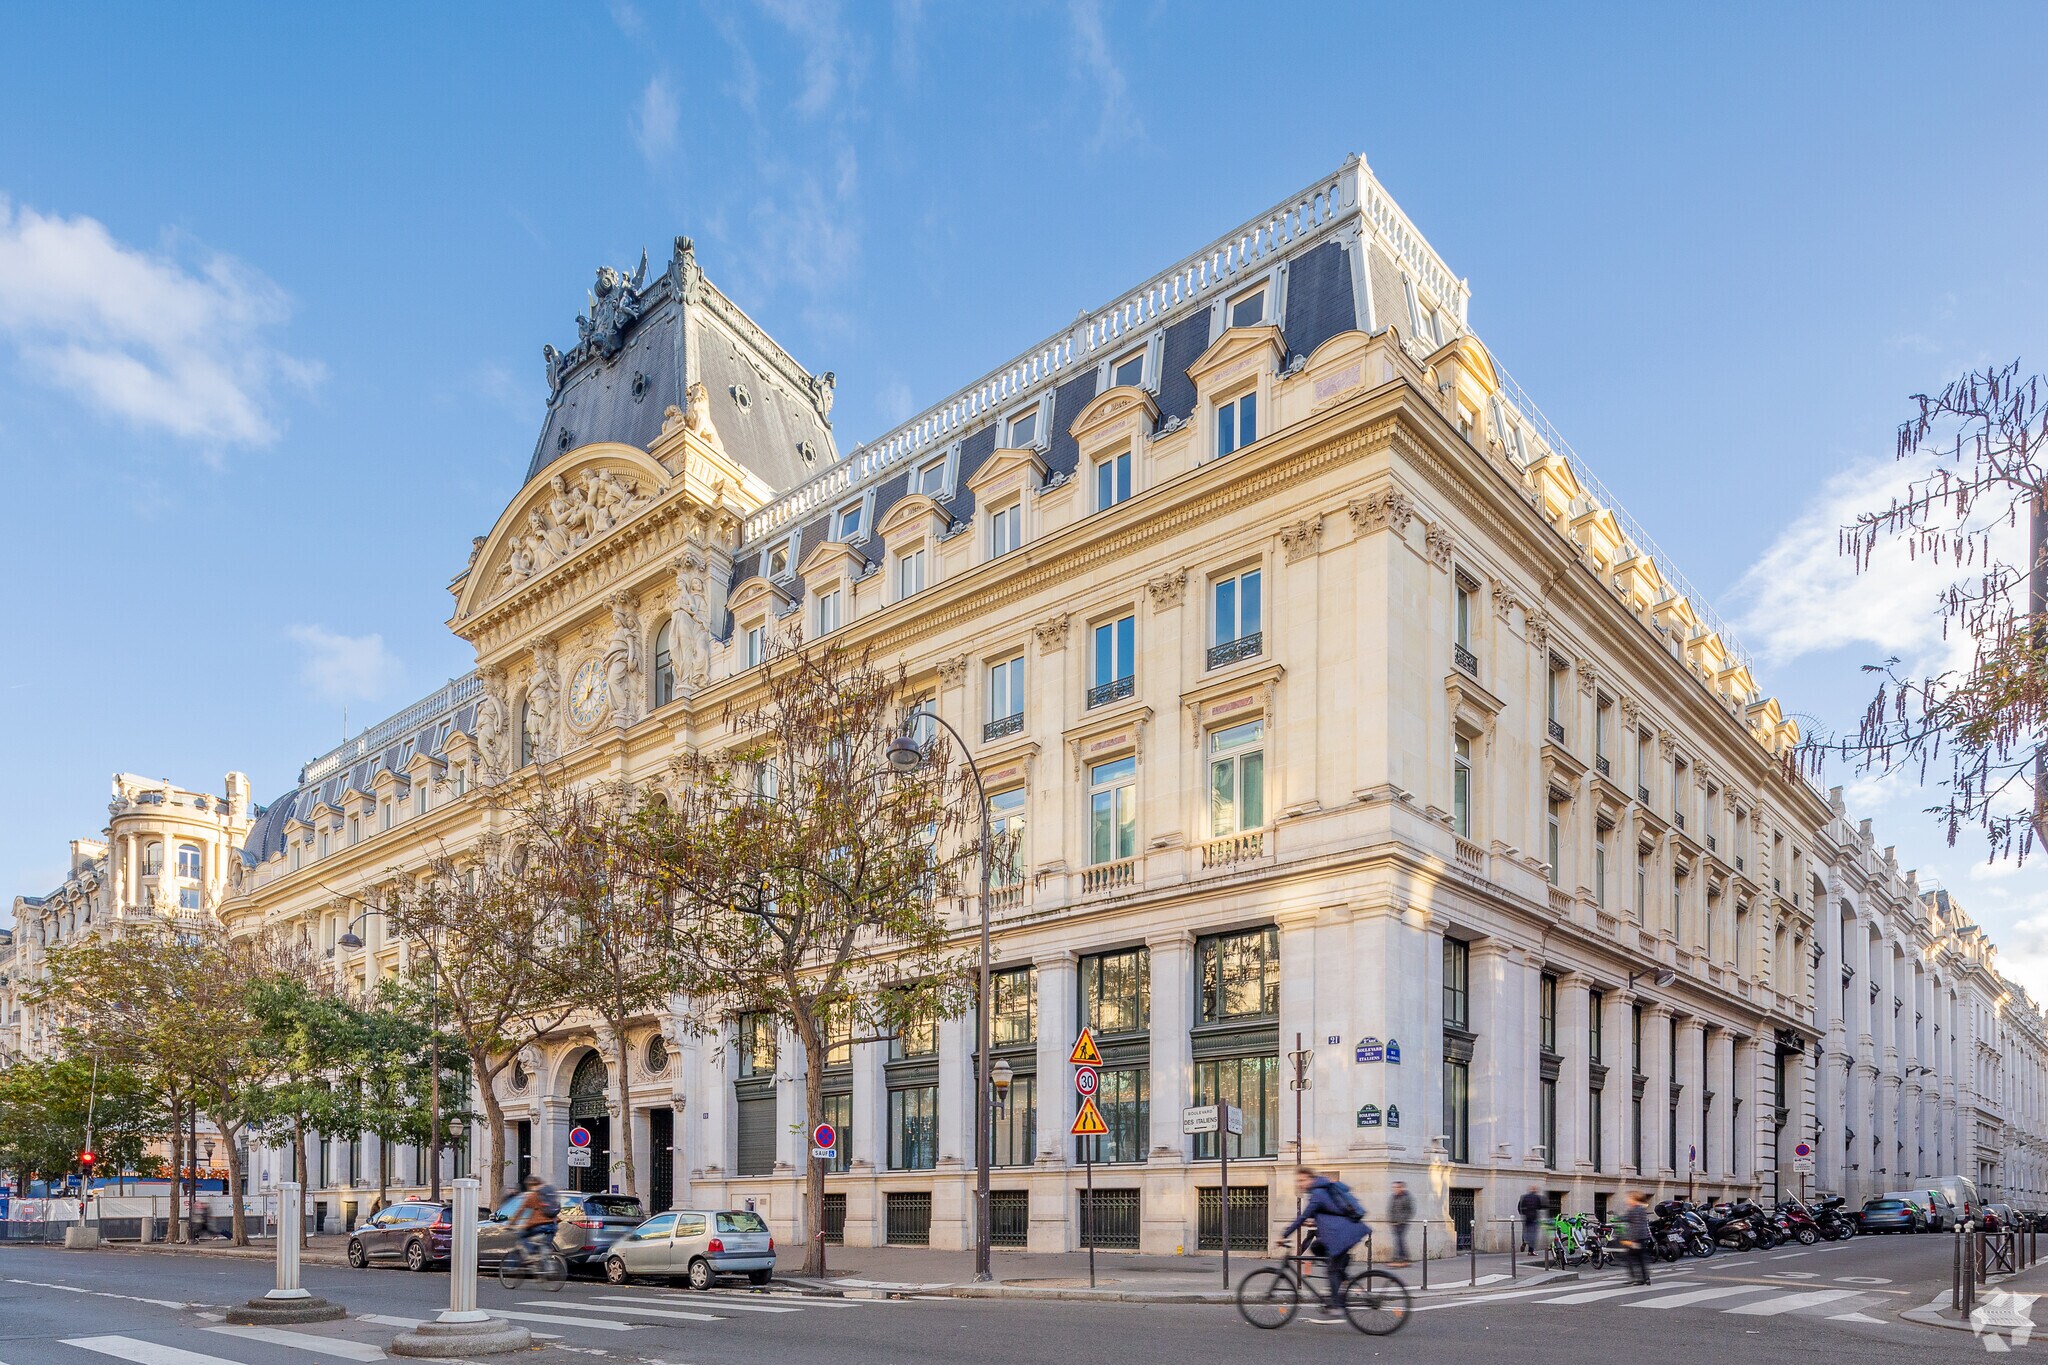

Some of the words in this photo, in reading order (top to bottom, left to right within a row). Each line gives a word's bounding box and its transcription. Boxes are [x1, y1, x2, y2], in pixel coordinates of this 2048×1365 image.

[1330, 1036, 1338, 1044] 21
[1081, 1075, 1093, 1089] 30
[1195, 1116, 1217, 1124] ITALIENS
